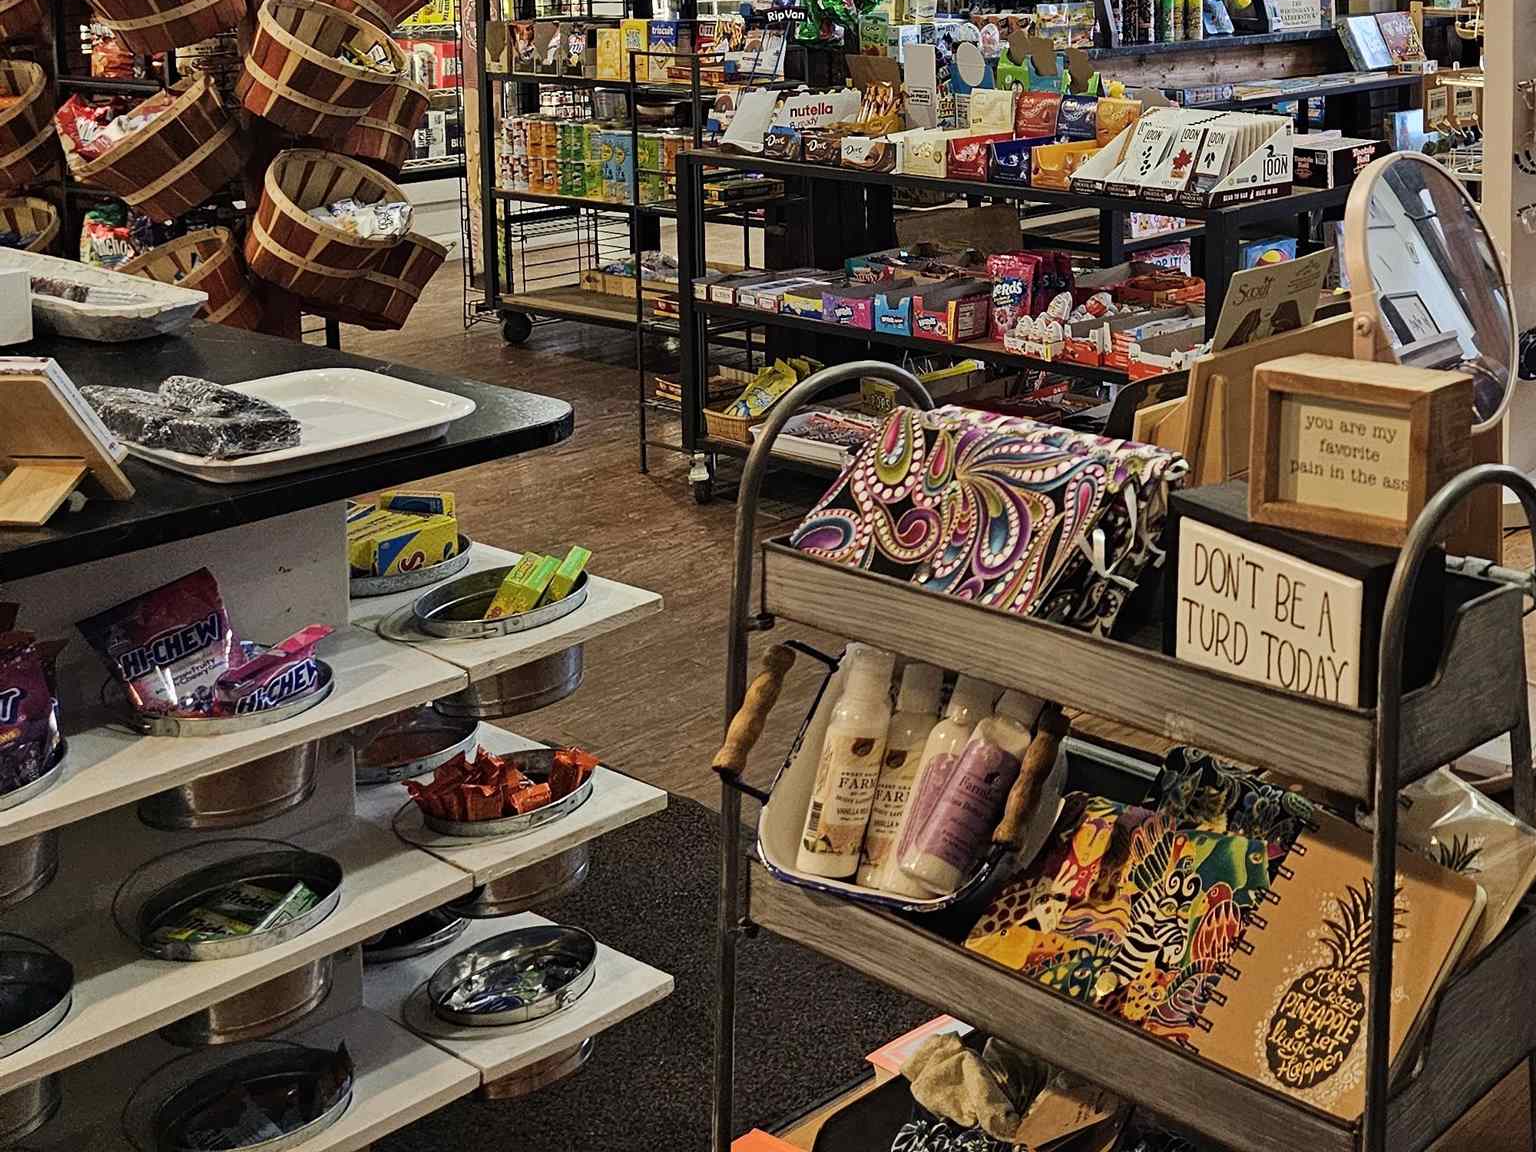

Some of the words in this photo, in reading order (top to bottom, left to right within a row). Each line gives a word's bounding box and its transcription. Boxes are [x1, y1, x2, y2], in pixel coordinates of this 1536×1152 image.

[767, 9, 785, 23] Rip
[786, 9, 805, 21] Van
[651, 25, 674, 36] triscuit
[789, 102, 833, 118] nutella
[1142, 129, 1162, 143] LOON
[1180, 127, 1200, 142] LOON
[1206, 131, 1226, 146] LOON
[1262, 156, 1288, 182] LOON
[1304, 412, 1334, 433] you
[1339, 420, 1368, 436] are
[1372, 424, 1397, 444] my
[1319, 440, 1382, 463] favorite
[1290, 458, 1326, 479] pain
[1329, 462, 1346, 479] in
[1350, 467, 1378, 486] the
[1382, 476, 1409, 491] ass
[1193, 542, 1264, 609] DON'T
[1274, 572, 1307, 631] BE
[1317, 591, 1337, 654] A
[121, 613, 222, 680] HI-CHEW
[1182, 597, 1249, 666] TURD
[1260, 629, 1349, 704] TODAY
[1279, 991, 1358, 1044] PINEAPPLE
